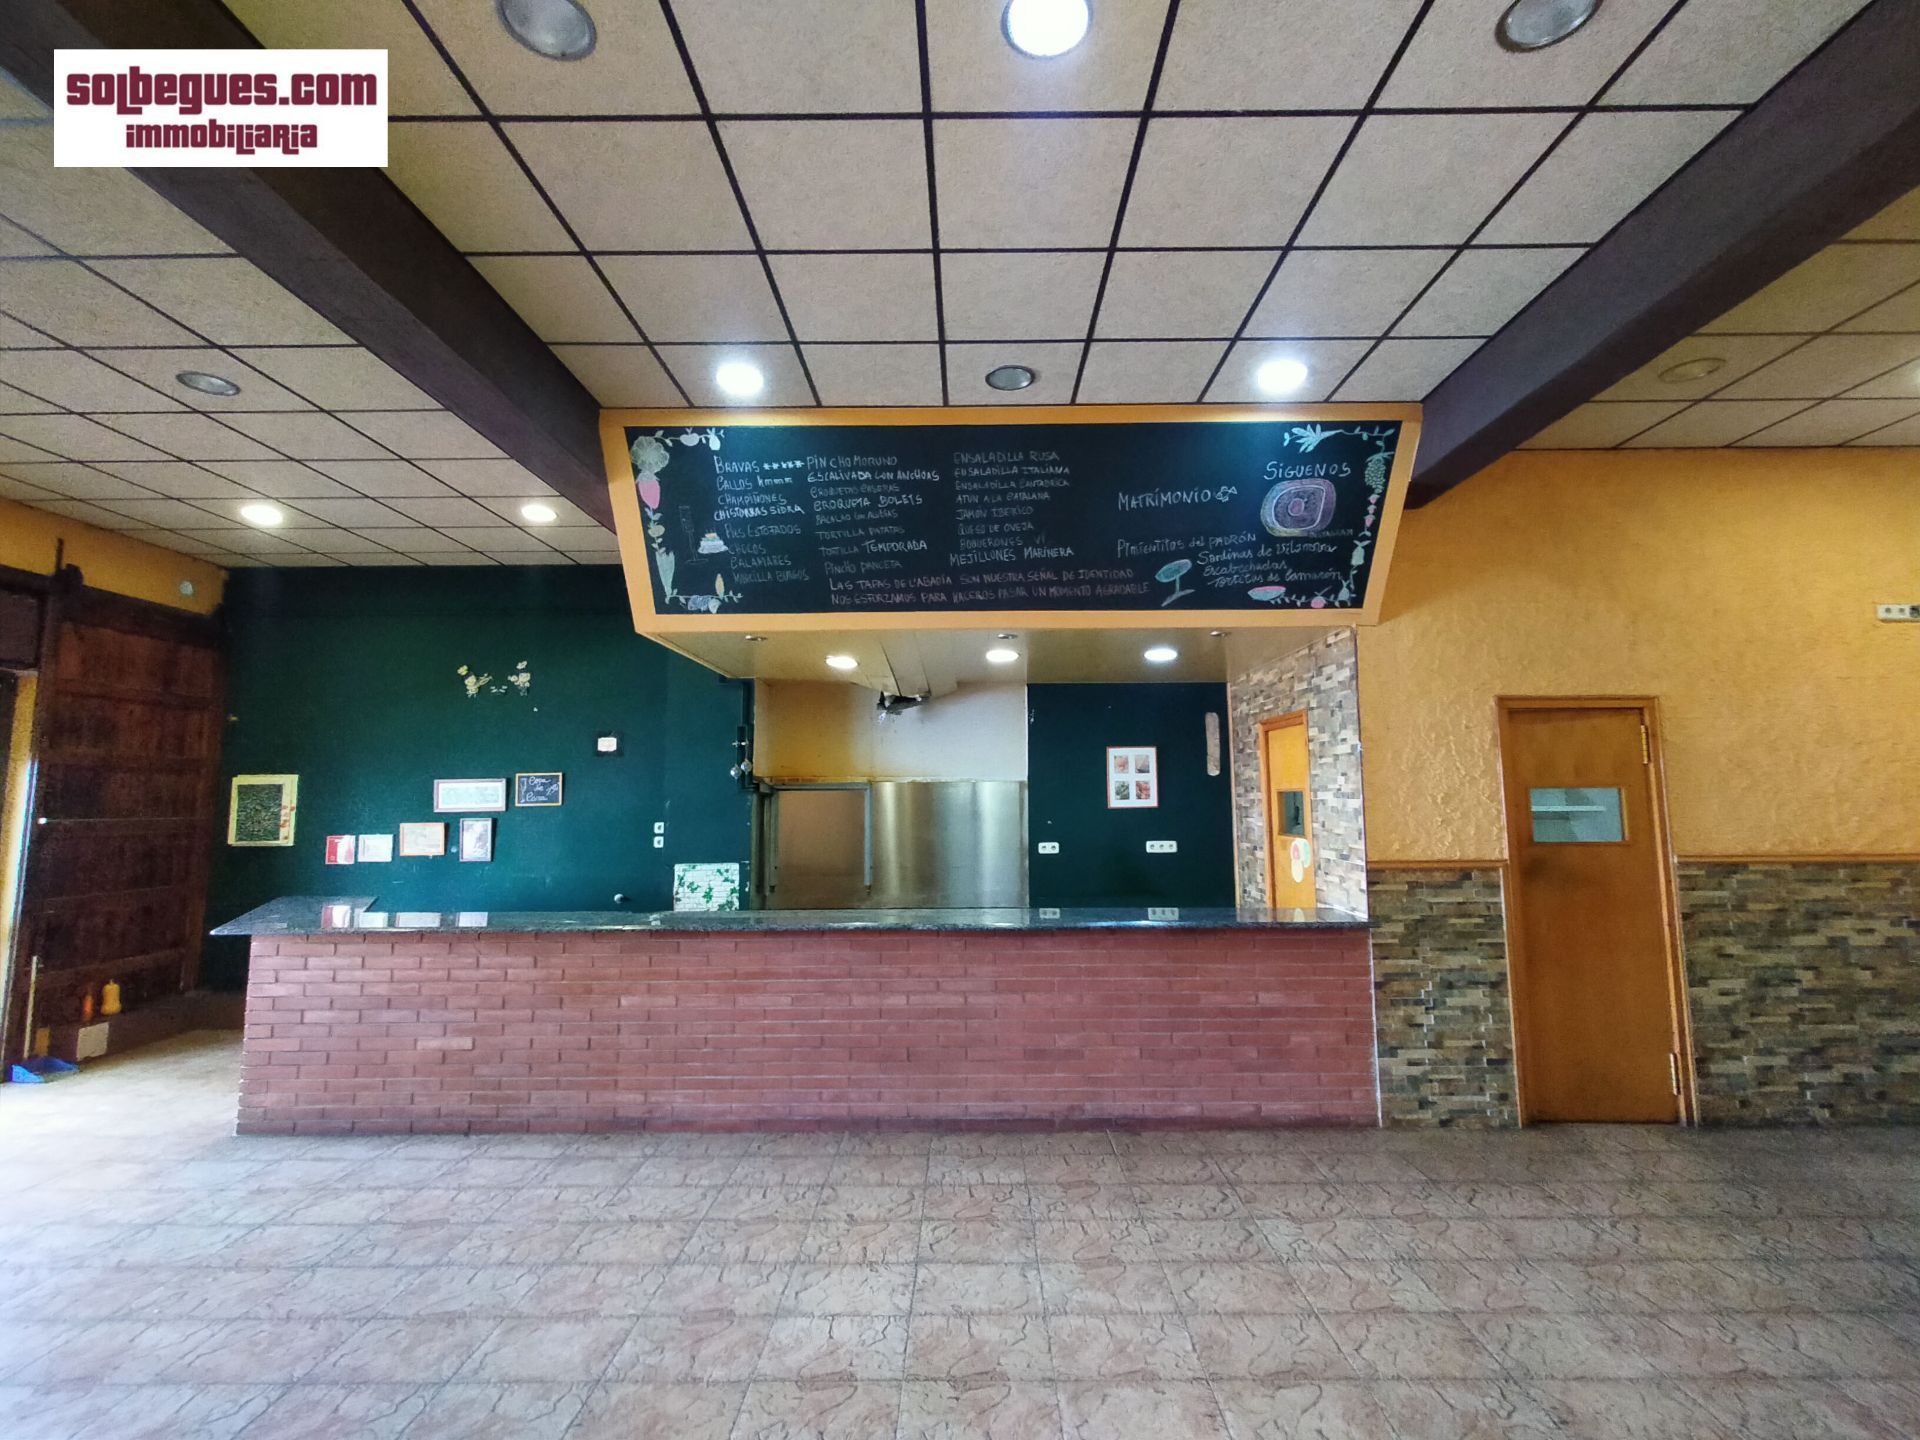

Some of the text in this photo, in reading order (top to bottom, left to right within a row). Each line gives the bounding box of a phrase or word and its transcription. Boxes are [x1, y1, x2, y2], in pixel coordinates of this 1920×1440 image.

[953, 450, 1060, 464] ENSALADILLA RUSA
[713, 455, 760, 474] BRAVAS
[874, 470, 894, 481] CON
[716, 475, 753, 491] CALLOS
[878, 494, 923, 508] BOLETS
[769, 503, 805, 515] SIDRA
[861, 539, 928, 554] TEMPORADA
[949, 549, 1016, 567] MEJILLONES
[829, 578, 853, 591] LAS
[855, 579, 891, 590] TAPAS
[1062, 570, 1074, 582] DE
[920, 592, 948, 604] PARA
